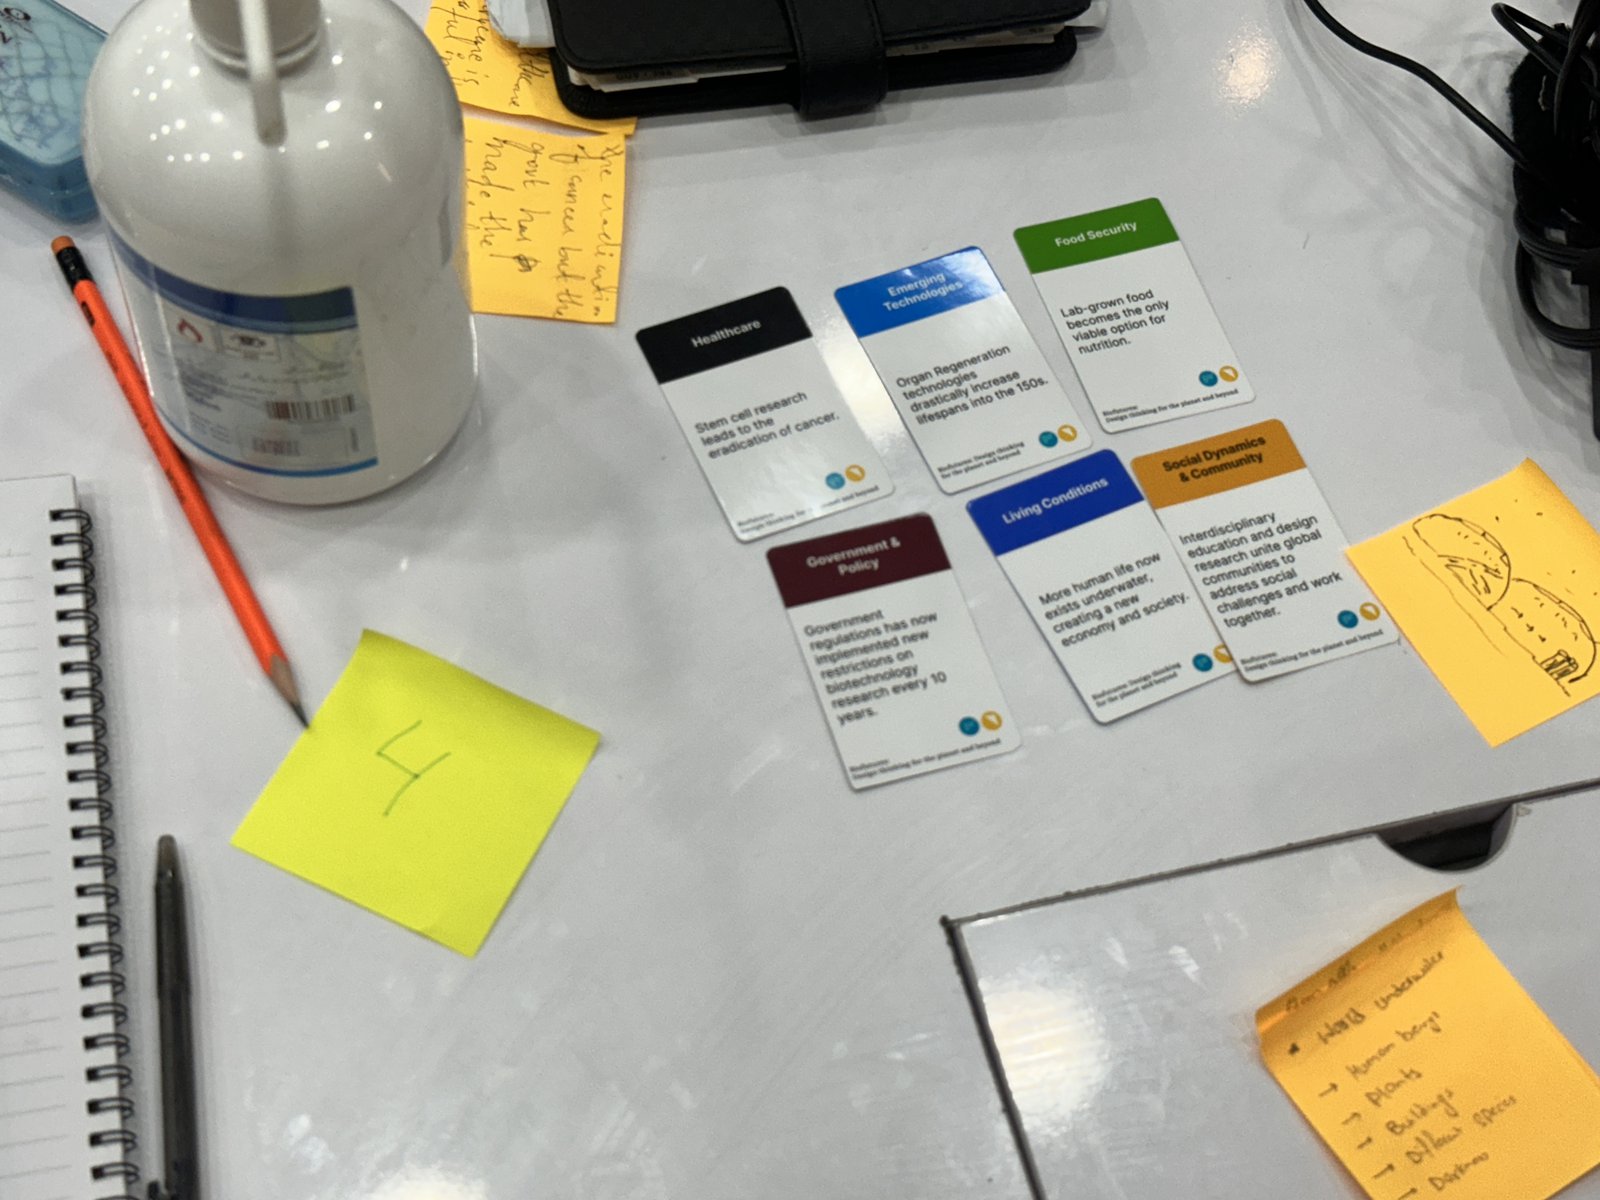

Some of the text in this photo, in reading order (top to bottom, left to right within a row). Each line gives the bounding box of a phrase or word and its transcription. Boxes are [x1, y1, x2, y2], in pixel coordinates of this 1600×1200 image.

[1055, 221, 1138, 247] Food Security
[883, 280, 964, 312] Technologies
[888, 272, 946, 297] Emerging
[1061, 289, 1154, 318] Lab-grown food
[1066, 300, 1169, 330] becomes the only
[692, 319, 761, 348] Healthcare
[1072, 313, 1166, 342] viable option for
[1078, 337, 1131, 355] nutrition.
[897, 345, 1011, 388] Organ Regeneration
[903, 370, 978, 400] technologies
[910, 371, 1020, 413] drastically increase
[916, 378, 1048, 425] lifespans into the 150s.
[695, 392, 807, 433] Stem cell research
[701, 417, 775, 446] leads to the
[708, 412, 839, 459] eradication of cancer.
[1163, 435, 1266, 472] Social Dynamics
[1180, 451, 1264, 483] & Community
[1002, 477, 1109, 525] Living Conditions
[1180, 512, 1276, 546] Interdisciplinary
[1187, 514, 1318, 559] education and design
[806, 536, 901, 568] Government &
[838, 557, 880, 577] Policy
[1194, 529, 1322, 573] research unite global
[1039, 552, 1161, 606] More human life now
[1202, 554, 1296, 587] communities to
[1210, 568, 1297, 601] address social
[1045, 573, 1154, 621] exists underwater,
[1217, 571, 1343, 615] challenges and work
[804, 609, 884, 637] Government
[1053, 593, 1140, 634] creating a new
[1061, 592, 1189, 647] economy and society.
[1224, 606, 1281, 628] together.
[809, 612, 938, 653] regulations has now
[815, 630, 929, 666] implemented new
[821, 650, 914, 680] restrictions on
[826, 663, 918, 696] biotechnology
[831, 671, 947, 709] research every 10
[837, 708, 878, 726] years.
[375, 719, 451, 818] 4
